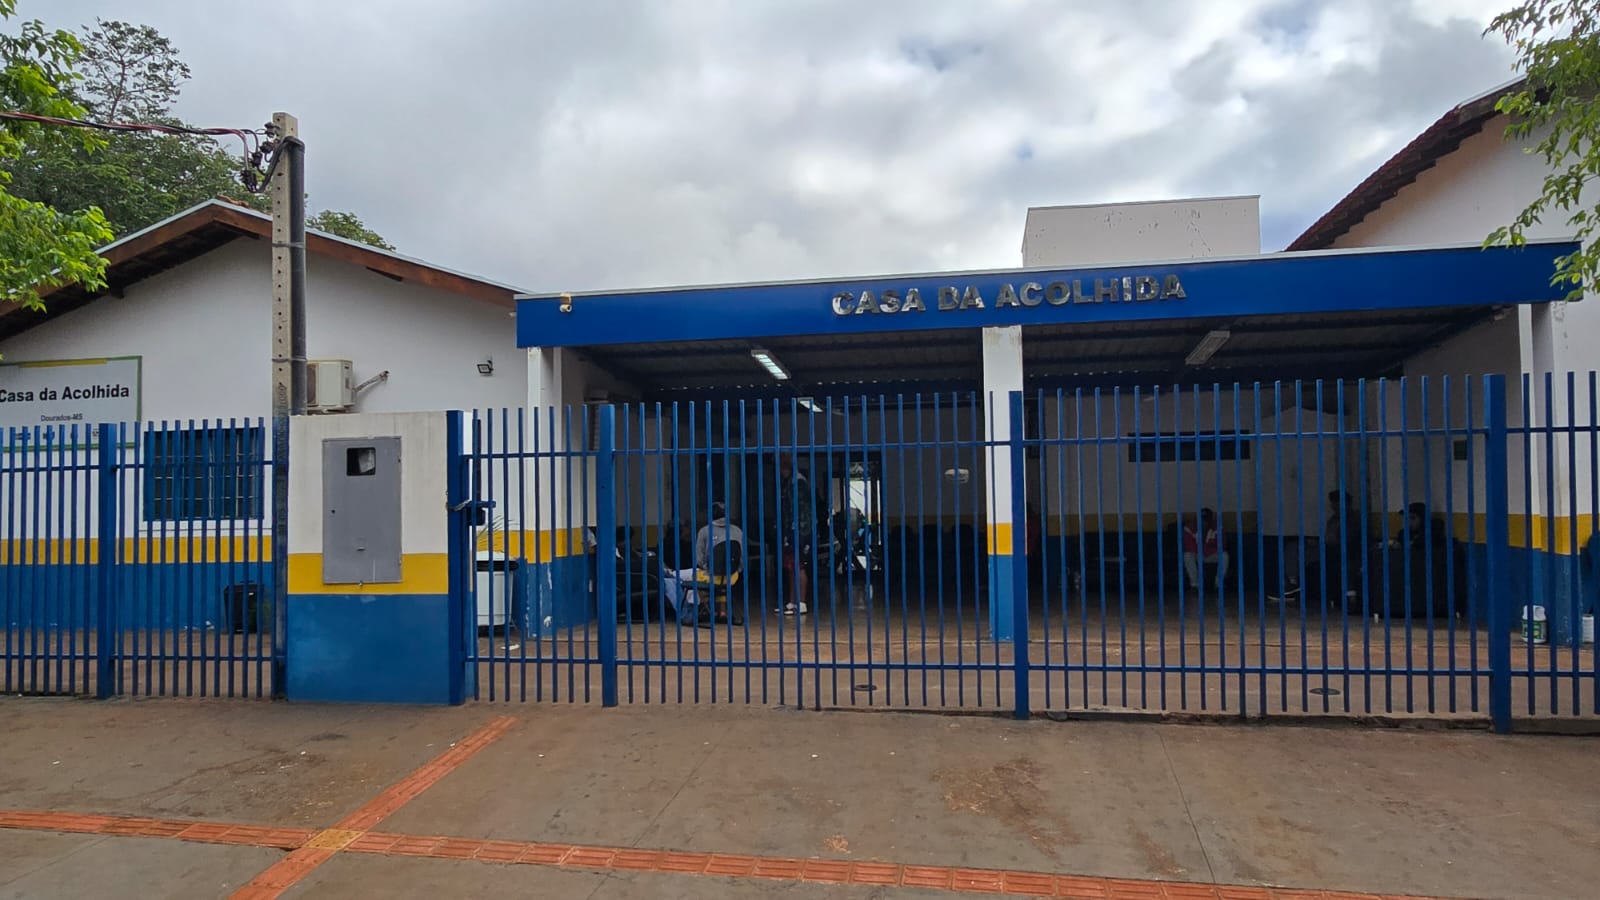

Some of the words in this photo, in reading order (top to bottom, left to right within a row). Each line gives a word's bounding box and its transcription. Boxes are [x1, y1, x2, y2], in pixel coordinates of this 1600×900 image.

[832, 289, 926, 316] CASA
[938, 286, 984, 310] DA
[996, 274, 1186, 307] ACOLHIDA
[0, 390, 34, 402] Casa
[39, 388, 57, 400] da
[62, 384, 129, 400] Acolhida
